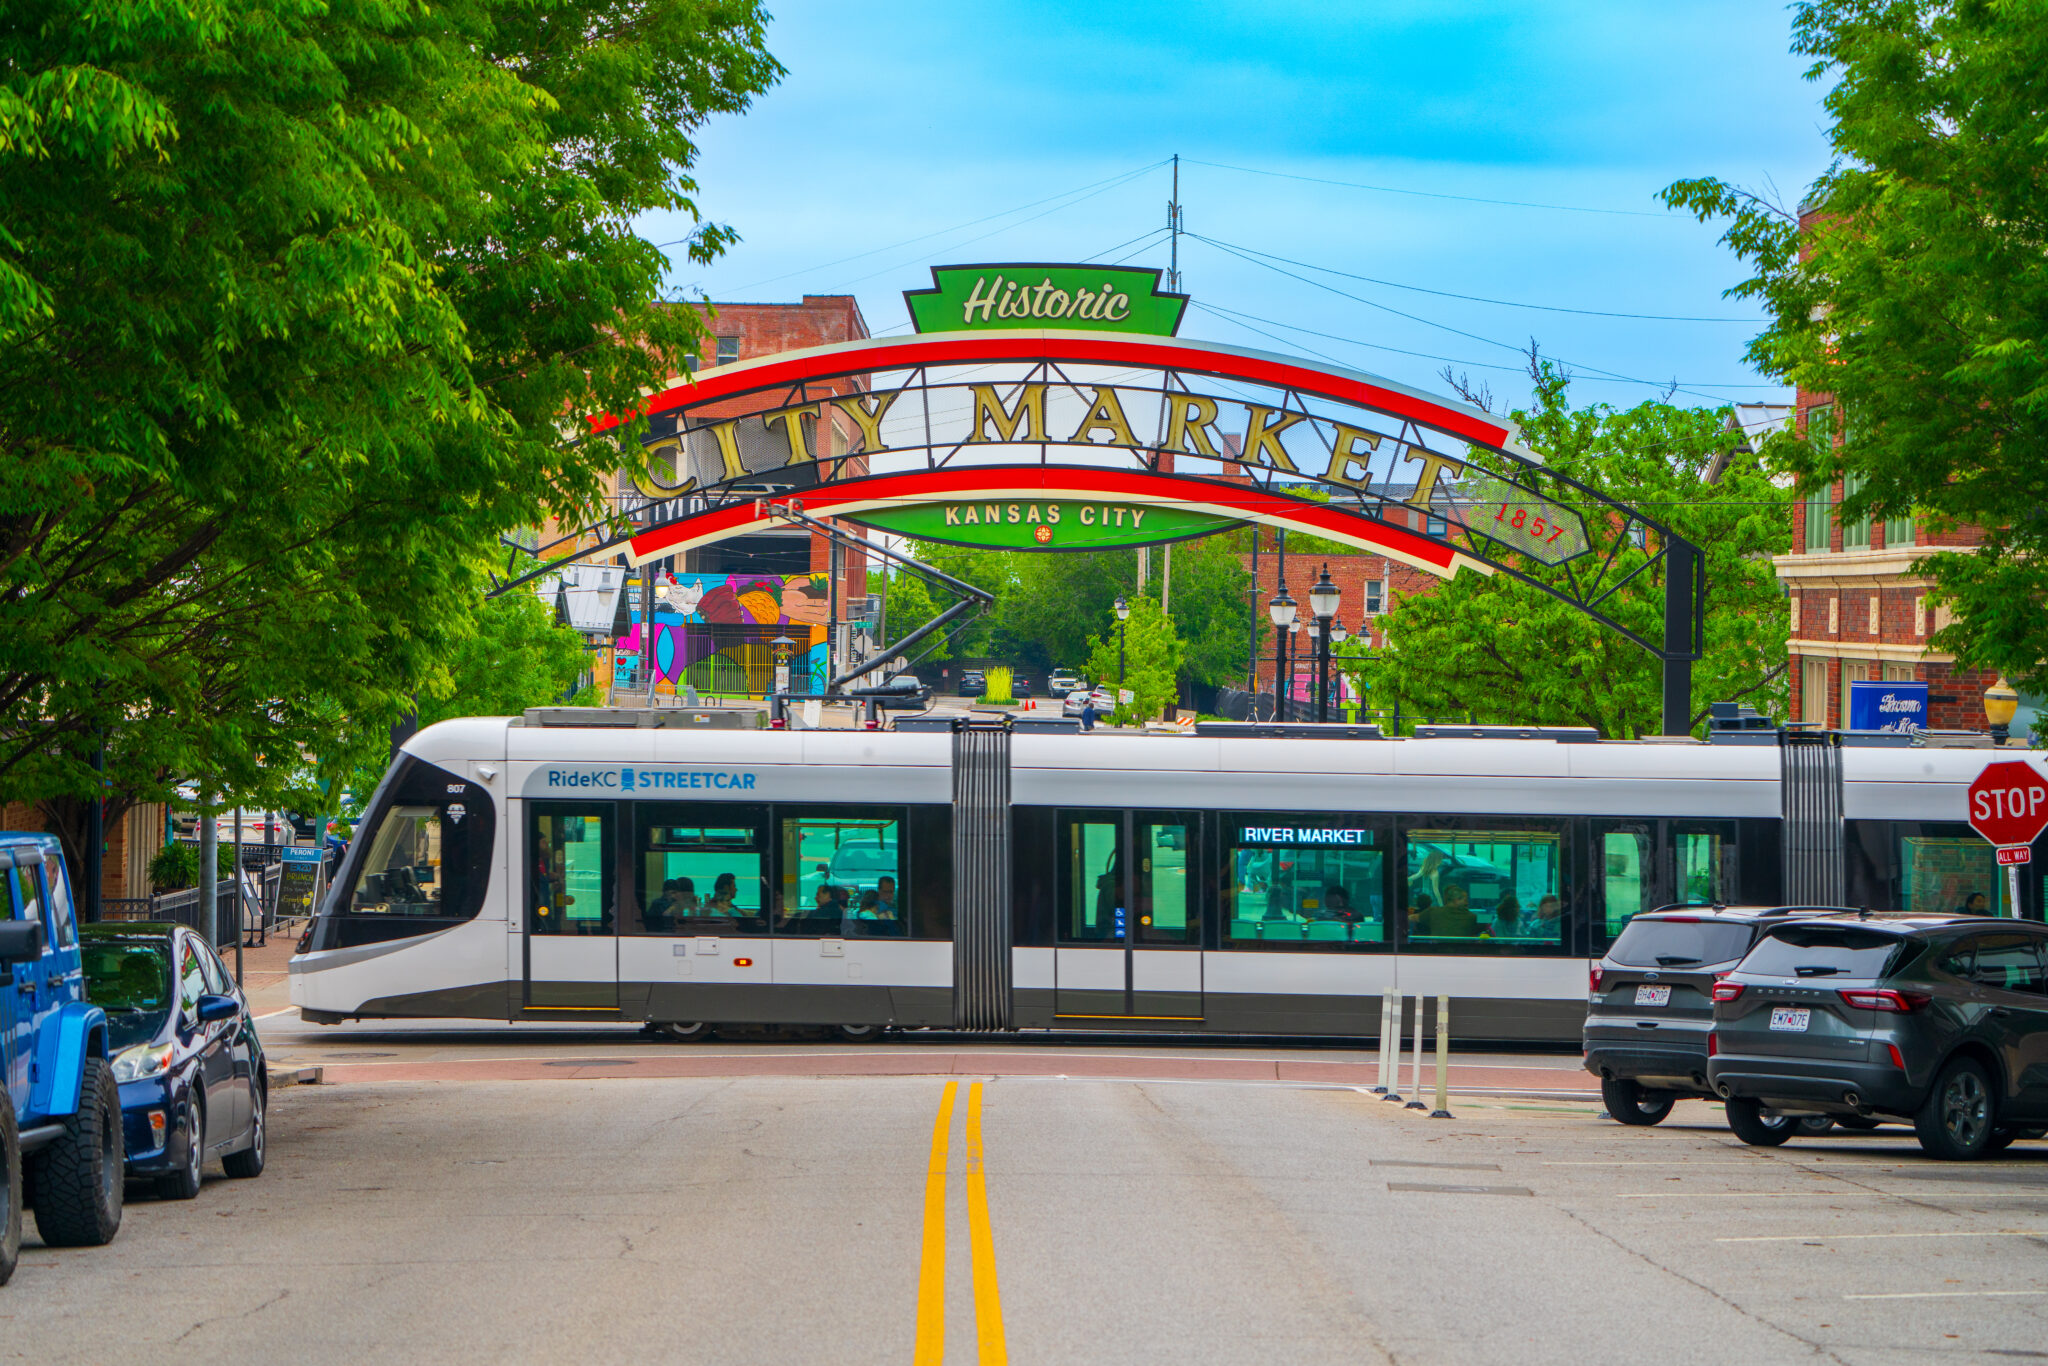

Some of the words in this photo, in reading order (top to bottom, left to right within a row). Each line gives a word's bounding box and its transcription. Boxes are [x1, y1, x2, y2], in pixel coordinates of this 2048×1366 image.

[963, 273, 1131, 324] Historic
[631, 391, 899, 500] CITY
[967, 384, 1464, 513] MARKET
[945, 504, 1061, 526] KANSAS
[1079, 505, 1146, 529] CITY
[1494, 503, 1565, 543] 1857
[446, 783, 466, 794] 807
[548, 770, 617, 788] RideKC
[638, 771, 757, 790] STREETCAR
[1974, 786, 2046, 821] STOP
[1244, 827, 1295, 842] RIVER
[1298, 828, 1366, 843] MARKET
[289, 848, 315, 856] PERONI
[1998, 851, 2012, 862] ALL
[2013, 849, 2028, 861] WAY
